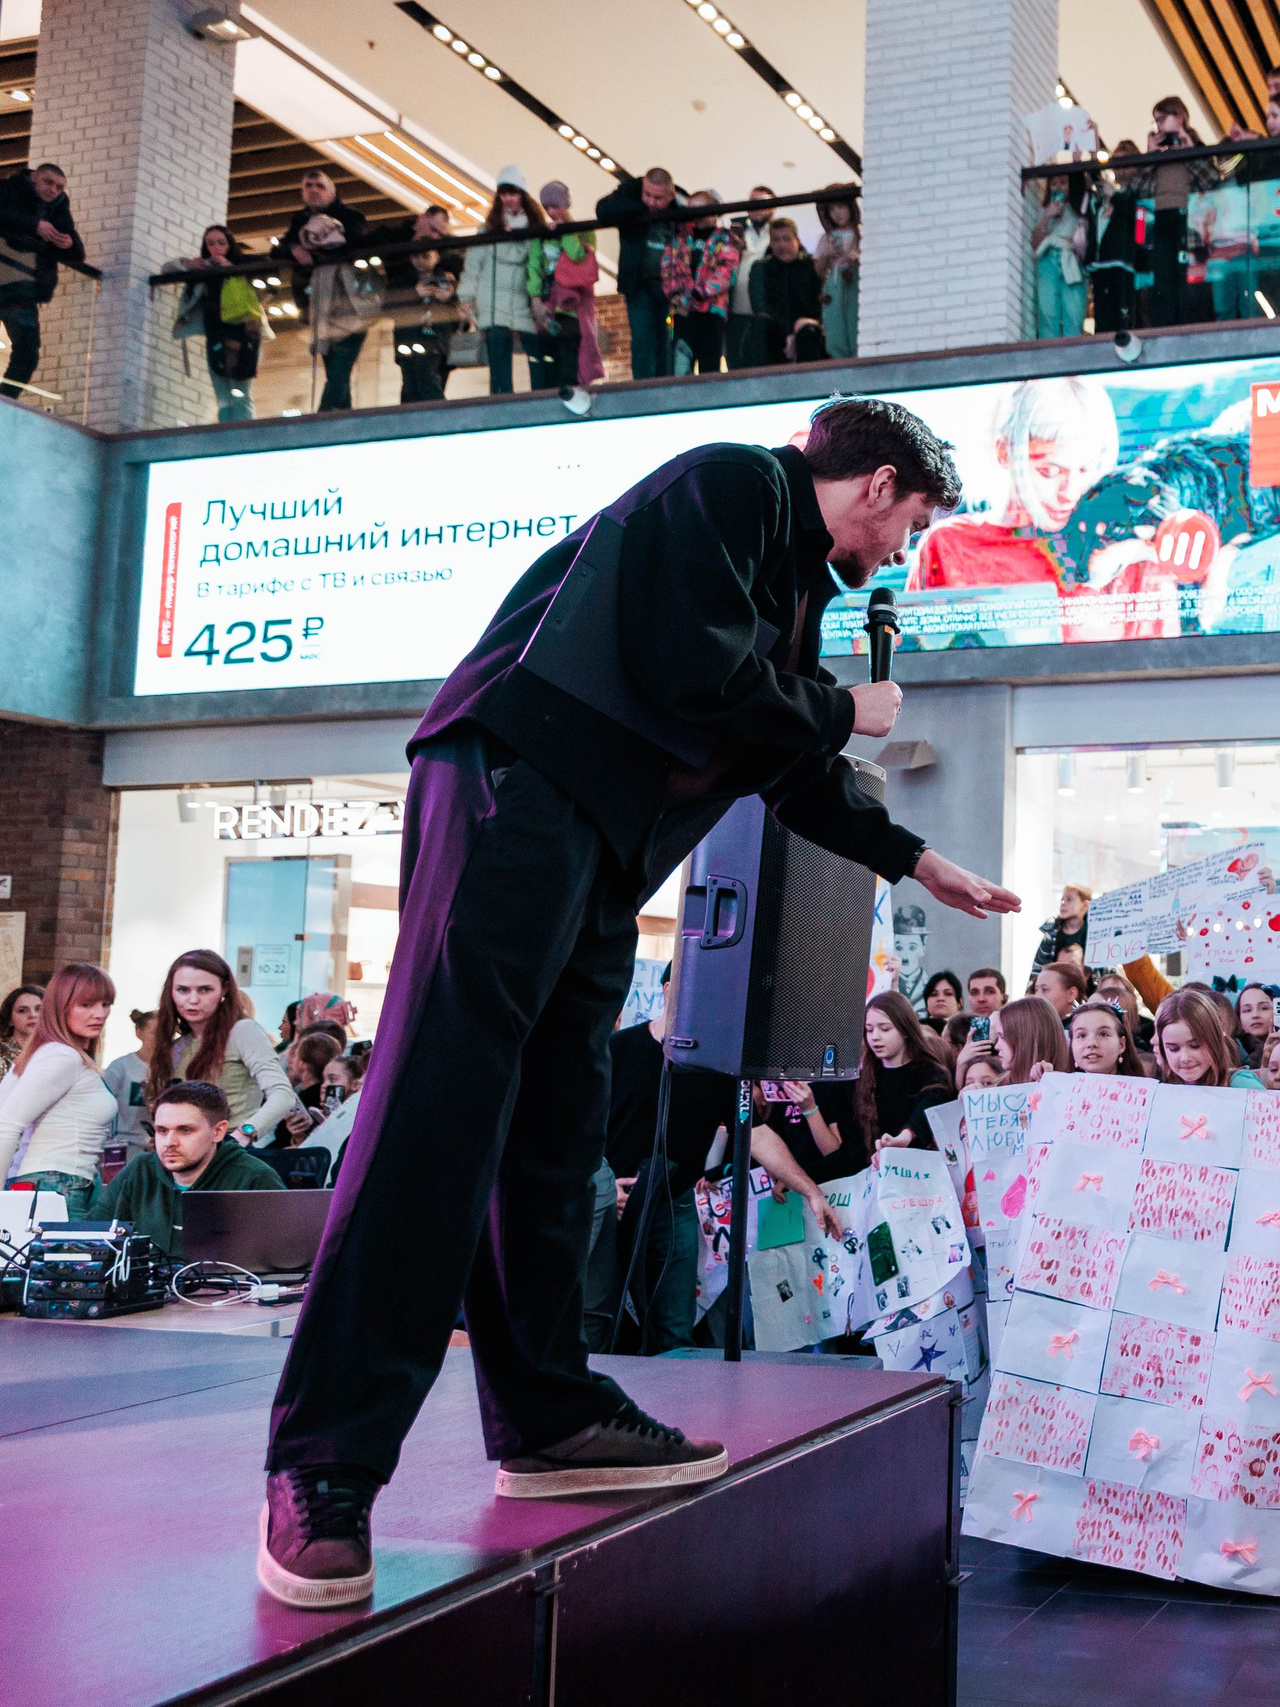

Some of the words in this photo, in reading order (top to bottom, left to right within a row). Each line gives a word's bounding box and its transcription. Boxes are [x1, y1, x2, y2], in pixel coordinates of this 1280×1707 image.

[201, 489, 343, 529] Лучший
[199, 521, 389, 568] домашний
[400, 511, 580, 552] интернет
[196, 580, 212, 598] В
[216, 572, 296, 600] тарифе
[318, 571, 348, 591] ТВ
[370, 565, 454, 585] связью
[184, 617, 295, 667] 425
[968, 1093, 1001, 1118] МЫ
[970, 1113, 1019, 1132] ТЕБЯ
